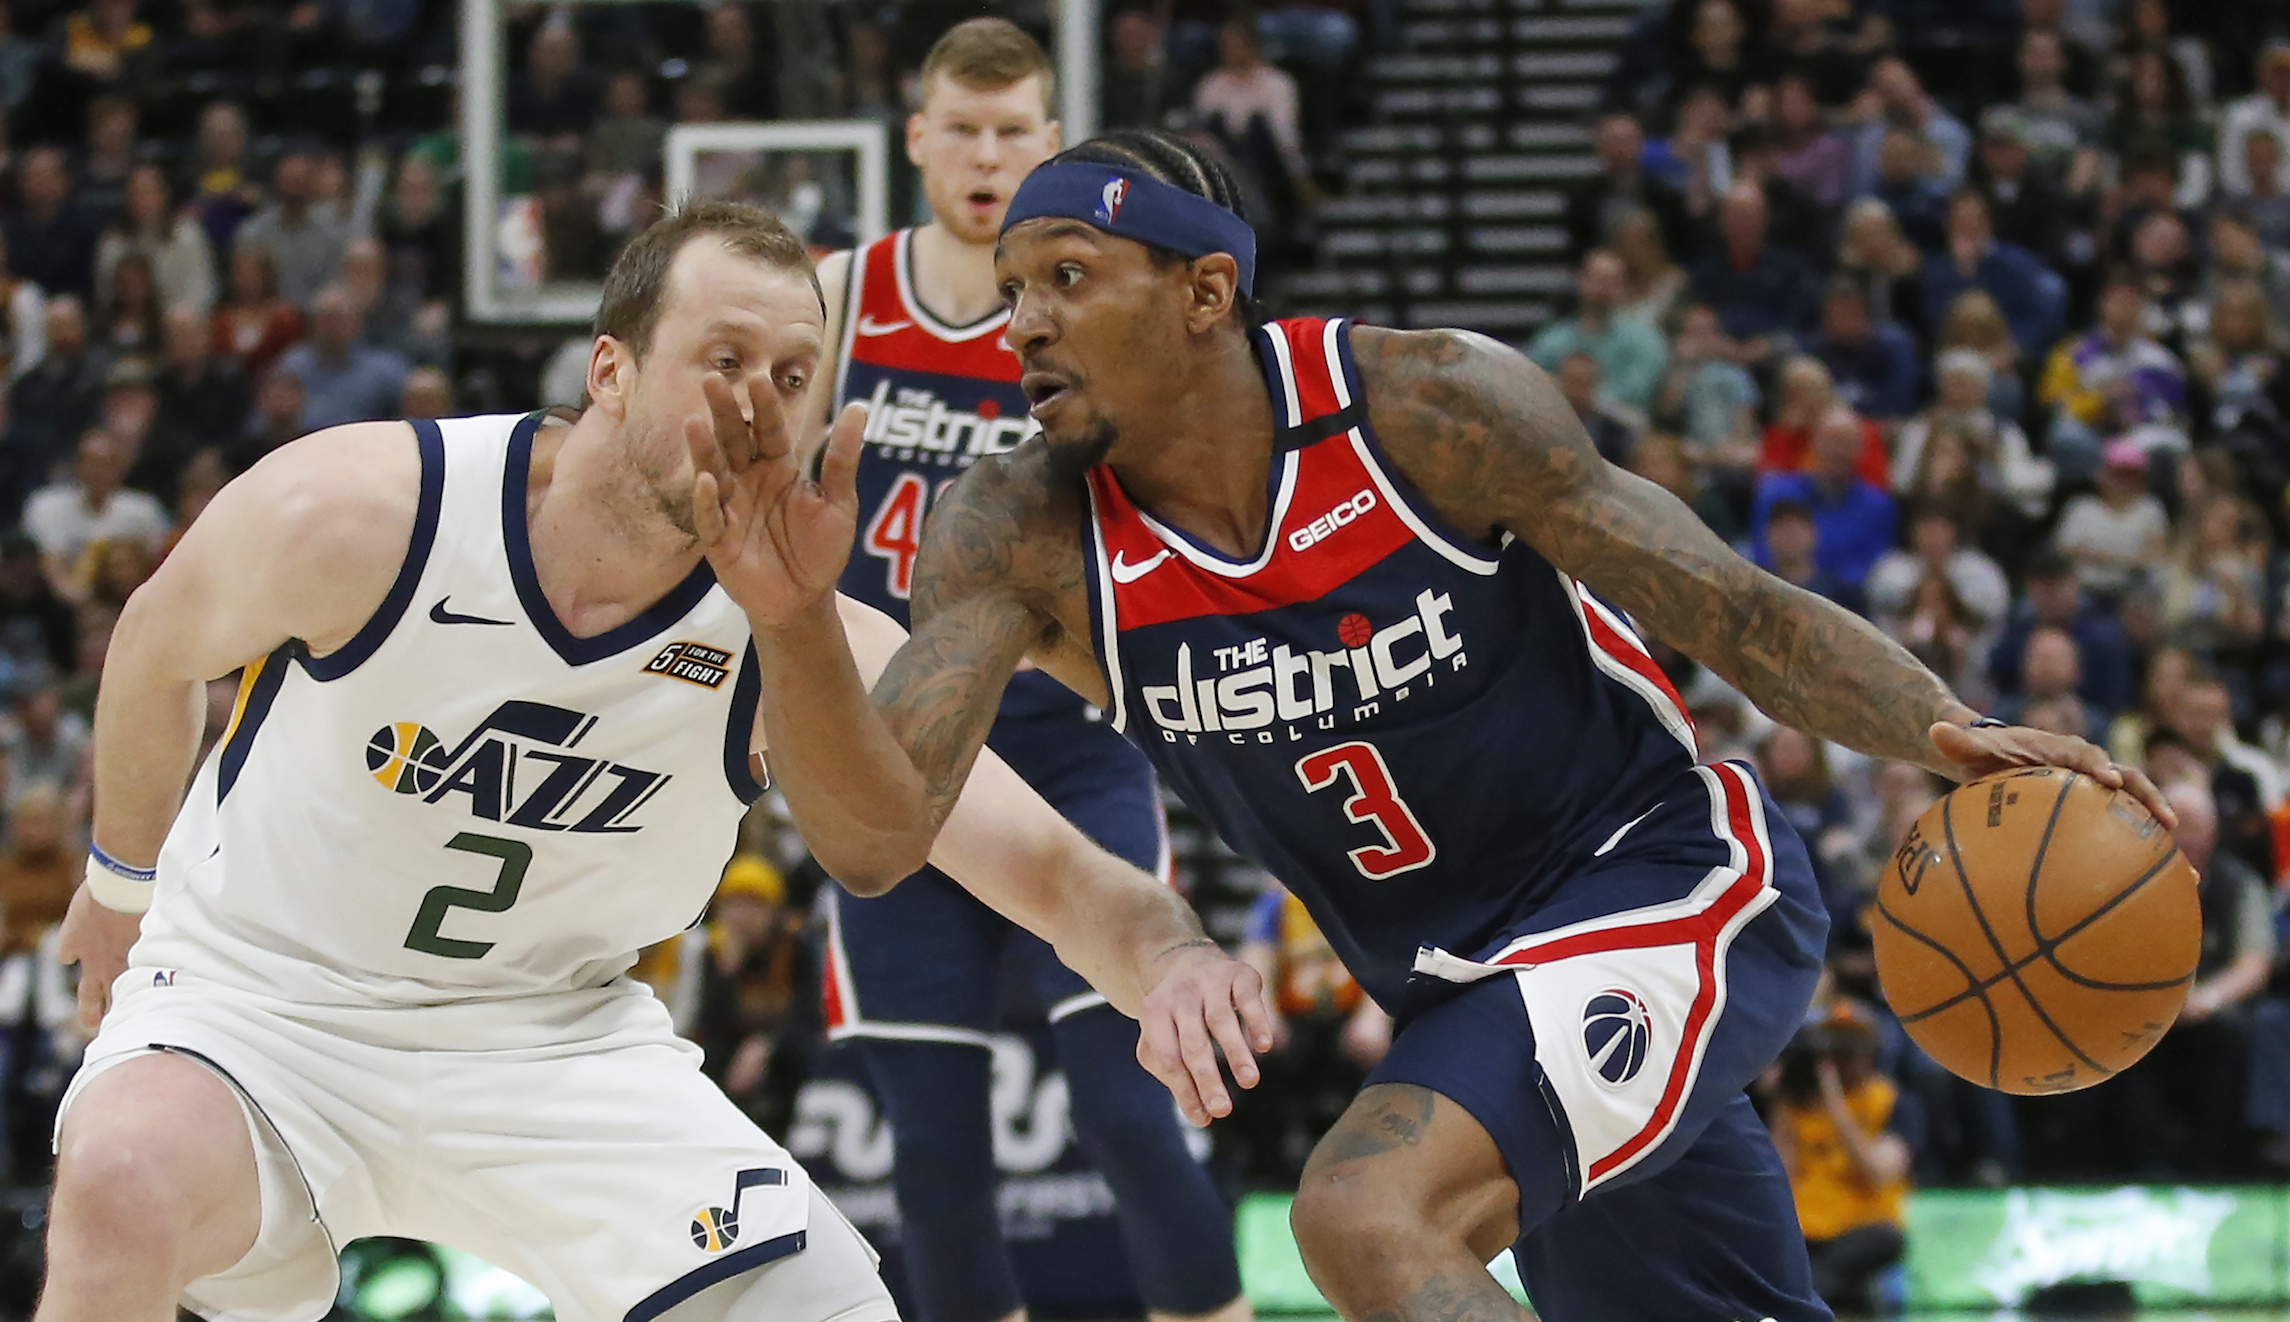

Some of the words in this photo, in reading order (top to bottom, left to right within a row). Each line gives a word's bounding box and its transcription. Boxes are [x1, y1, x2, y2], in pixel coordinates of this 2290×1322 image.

[863, 472, 954, 599] 4
[1288, 487, 1377, 552] GEICO
[650, 644, 683, 671] 5
[672, 660, 724, 685] FIGHT
[687, 646, 708, 658] FOR
[707, 651, 727, 664] THE
[1142, 587, 1464, 733] district
[1161, 729, 1199, 746] OF
[1227, 652, 1468, 746] COLUMBIA
[1213, 637, 1269, 672] THE
[366, 700, 673, 833] JAZZ
[1294, 740, 1437, 882] 3
[403, 831, 534, 960] 2
